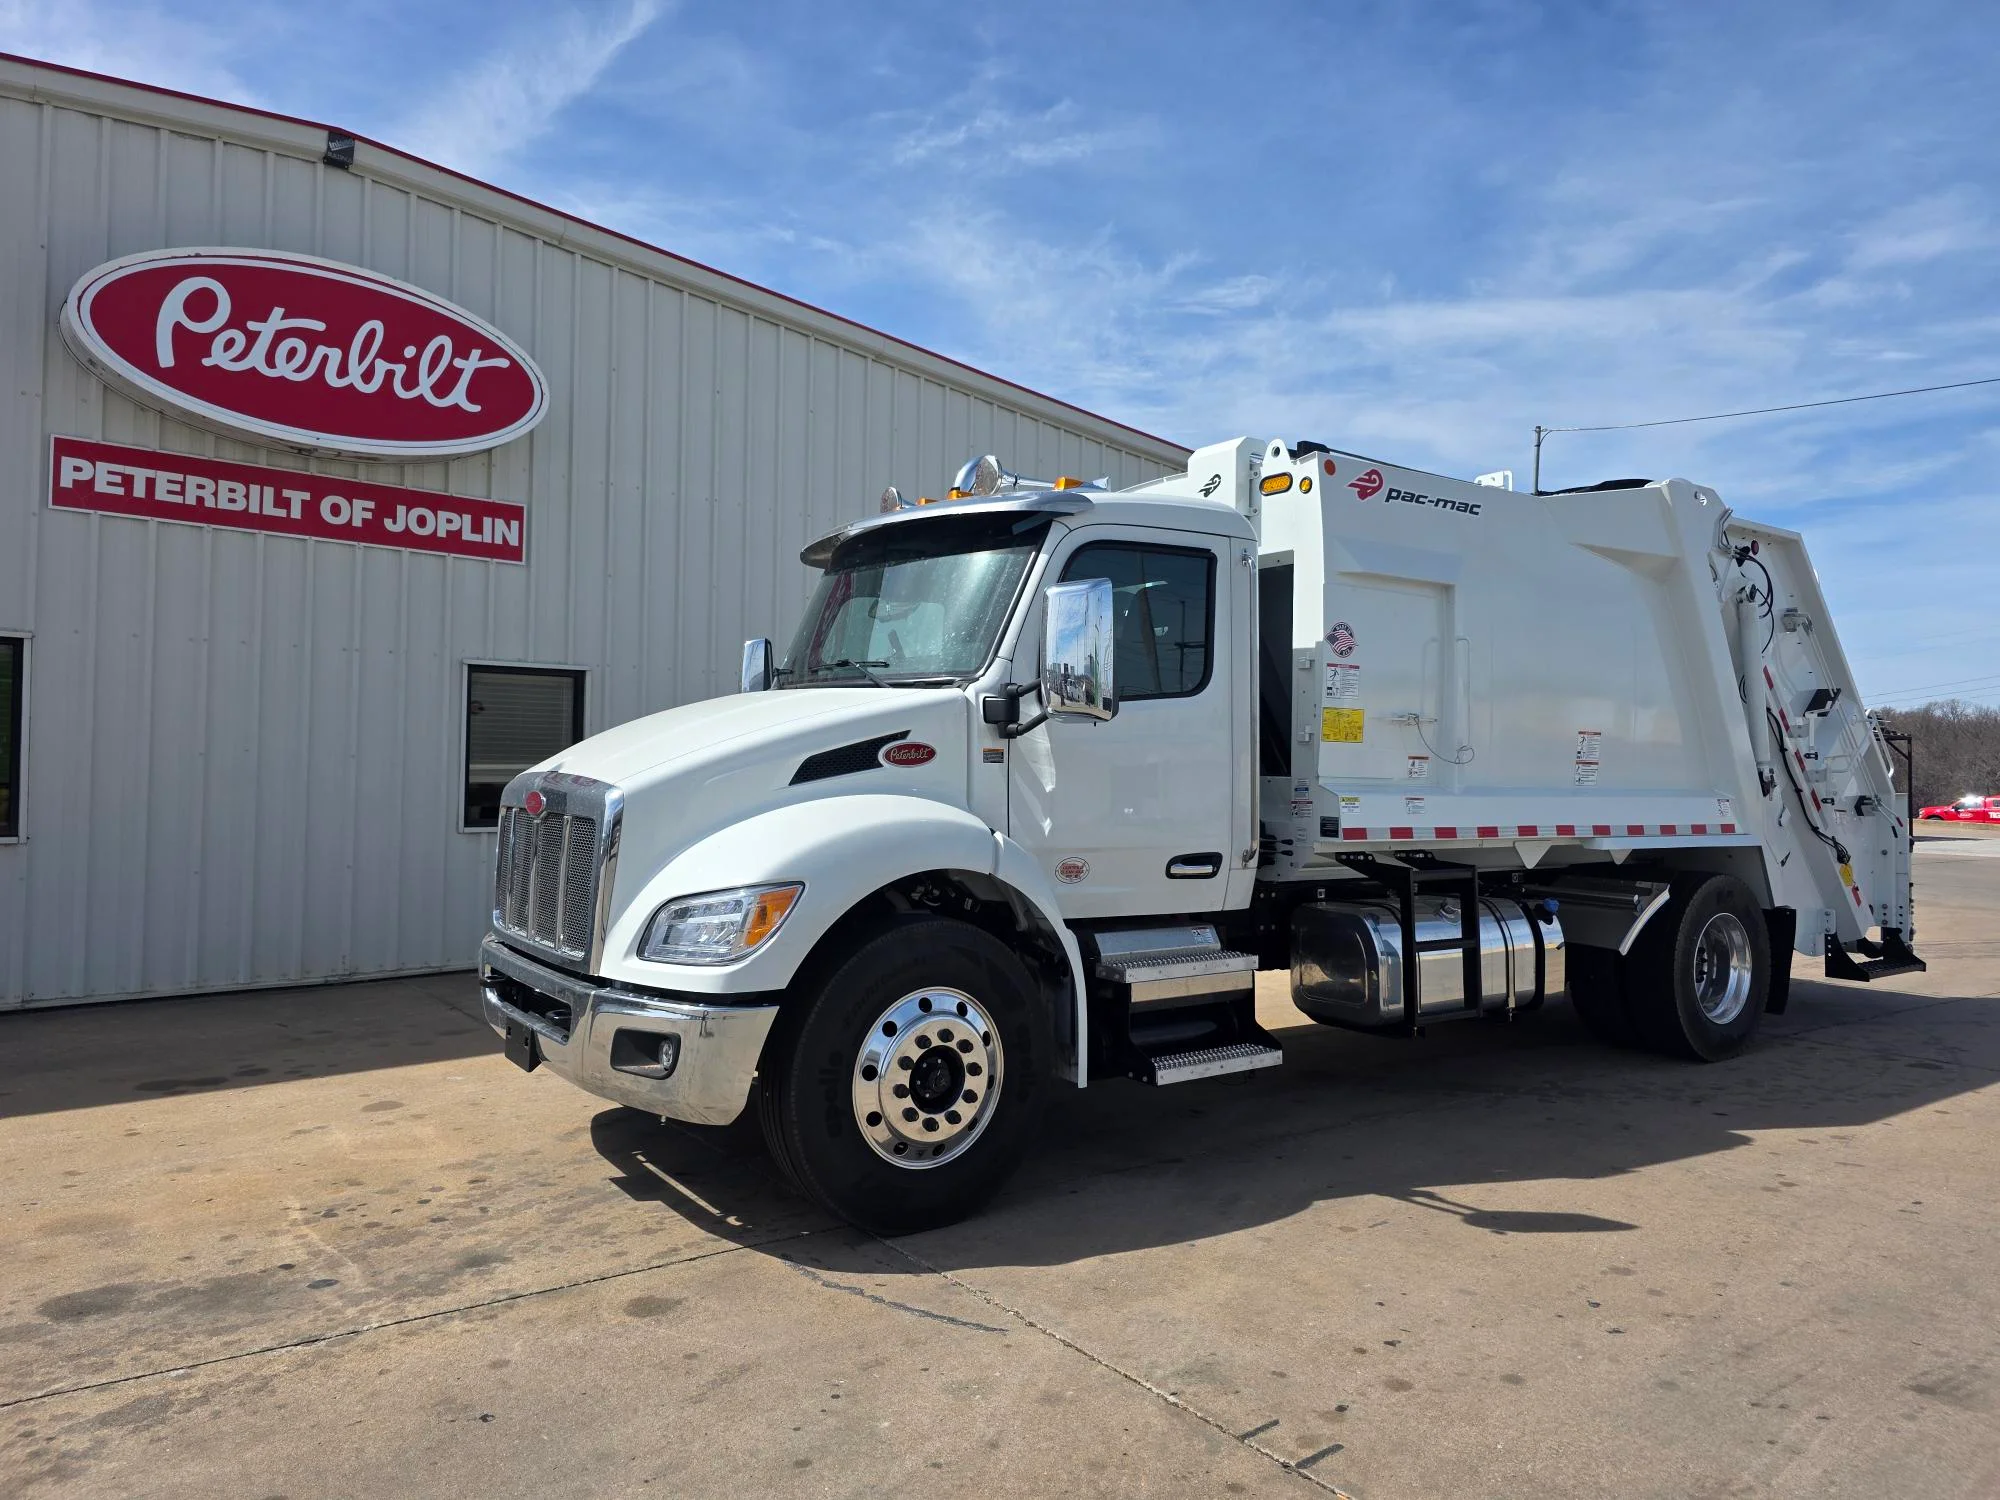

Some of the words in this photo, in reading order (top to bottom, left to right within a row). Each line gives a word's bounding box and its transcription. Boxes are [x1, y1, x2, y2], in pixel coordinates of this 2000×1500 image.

[156, 276, 510, 413] Peterbilt
[59, 456, 311, 519] PETERBILT
[319, 496, 376, 527] OF
[383, 504, 520, 547] JOPLIN
[1384, 487, 1482, 516] pac-mac
[890, 747, 932, 761] Peterbilt
[817, 1049, 848, 1139] apollo
